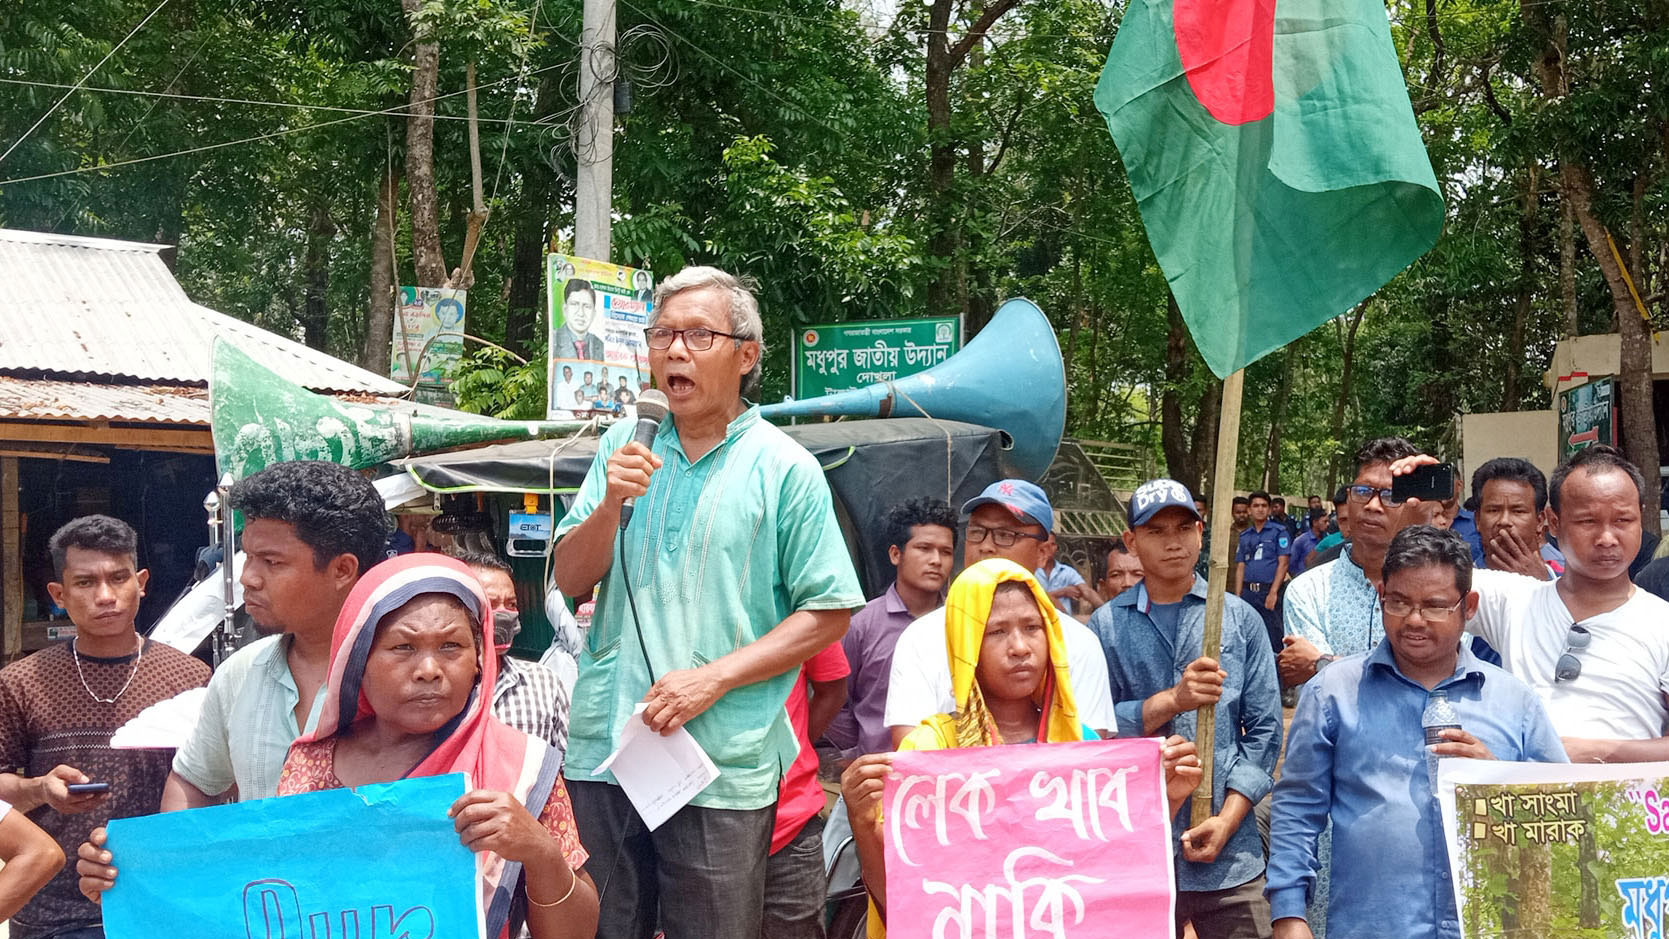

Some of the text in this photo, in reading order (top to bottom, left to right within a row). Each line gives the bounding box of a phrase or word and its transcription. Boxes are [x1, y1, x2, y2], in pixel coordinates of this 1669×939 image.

[804, 341, 948, 374] মধুপুর জাতীয় উদ্যান
[1491, 790, 1579, 817] খা সাংমা
[1491, 819, 1586, 845] খা মারাক
